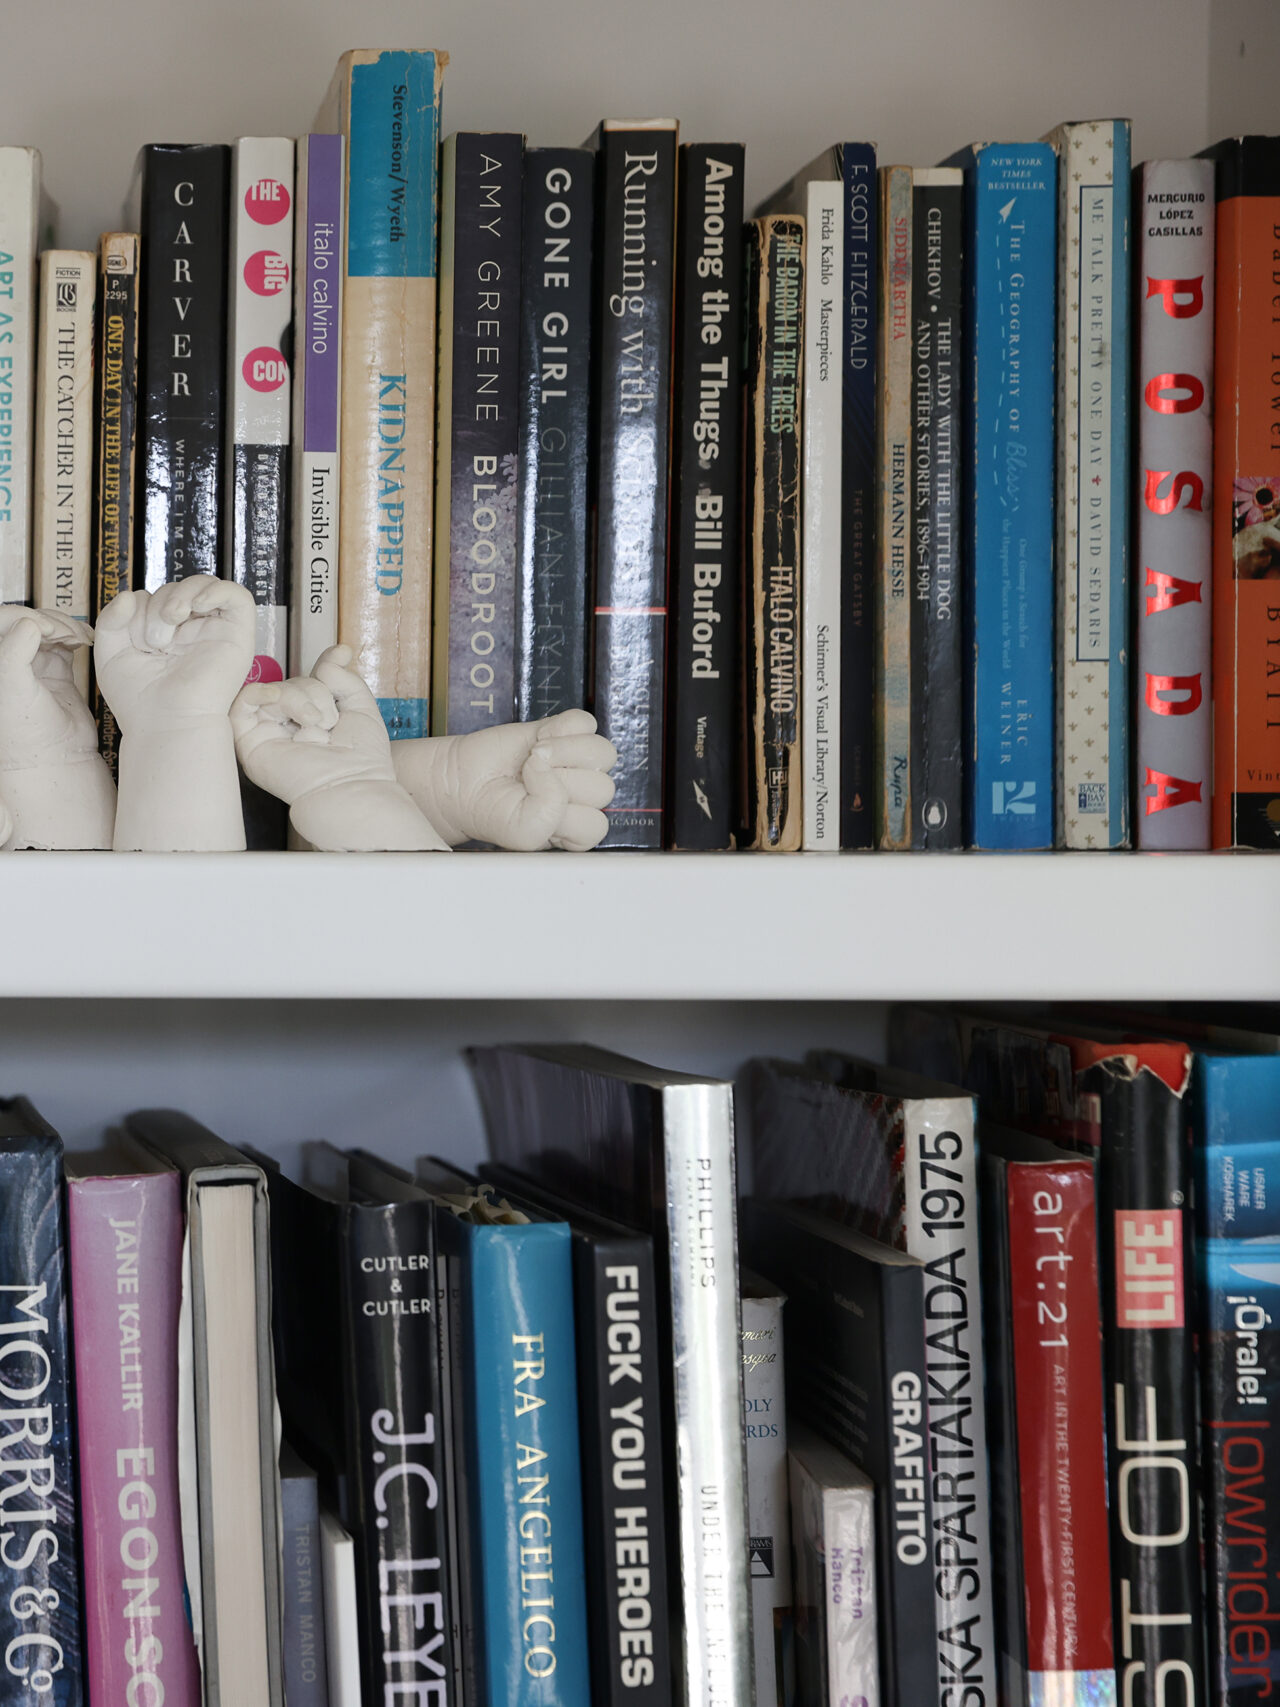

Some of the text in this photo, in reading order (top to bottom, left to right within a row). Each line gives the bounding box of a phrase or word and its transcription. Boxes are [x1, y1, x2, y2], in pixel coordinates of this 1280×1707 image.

[987, 181, 1046, 191] BESTSELLER
[991, 158, 1043, 167] NEW YORK
[1001, 169, 1033, 178] TIMES
[1147, 193, 1206, 204] MERCURIO
[1159, 209, 1194, 219] LÓPEZ
[171, 182, 195, 396] CARVER
[313, 222, 333, 354] italo calvino
[475, 153, 502, 422] AMY GREENE
[540, 167, 571, 404] GONE GIRL
[816, 207, 834, 382] Frida Kahlo Masterpieces
[893, 218, 908, 341] SIDDHARTHA
[926, 207, 942, 299] CHEKHOV
[1148, 228, 1204, 237] CASILLAS
[693, 158, 733, 460] Among the Thugs
[1089, 198, 1104, 464] ME TALK PRETTY ONE DAY
[174, 439, 185, 539] WHERE I'M
[374, 373, 407, 597] KIDNAPPED
[891, 443, 906, 598] HERMANN HESSE
[936, 318, 953, 620] THE LADY WITH THE LITTLE DOG
[309, 467, 330, 614] Invisible Cities
[469, 455, 497, 714] BLOODROOT
[690, 494, 724, 679] Bill Buford
[1088, 497, 1102, 648] DAVID SEDARIS
[694, 717, 707, 759] Vintage
[1000, 682, 1013, 765] WEINER
[1016, 699, 1030, 747] ERIC
[697, 1158, 717, 1288] PHILLIPS
[1222, 1156, 1237, 1222] KOSHAREK
[1238, 1170, 1251, 1207] WARE
[1253, 1167, 1266, 1210] USNER
[108, 1218, 145, 1411] JANE KALLIR
[361, 1255, 430, 1273] CUTLER
[362, 1298, 432, 1317] CUTLER
[390, 1278, 403, 1293] &
[1123, 1219, 1176, 1322] LIFE
[919, 1131, 982, 1602] SPARTAKIADA 1975
[1226, 1294, 1272, 1406] ¡Órale!
[512, 1331, 558, 1679] FRA ANGELICO
[604, 1264, 656, 1688] FUCK YOU HEROES
[891, 1370, 928, 1566] GRAFFITO
[1114, 1382, 1190, 1547] OF
[116, 1447, 161, 1619] EGON
[10, 1585, 61, 1619] &
[295, 1523, 317, 1683] TRISTAN MANCO
